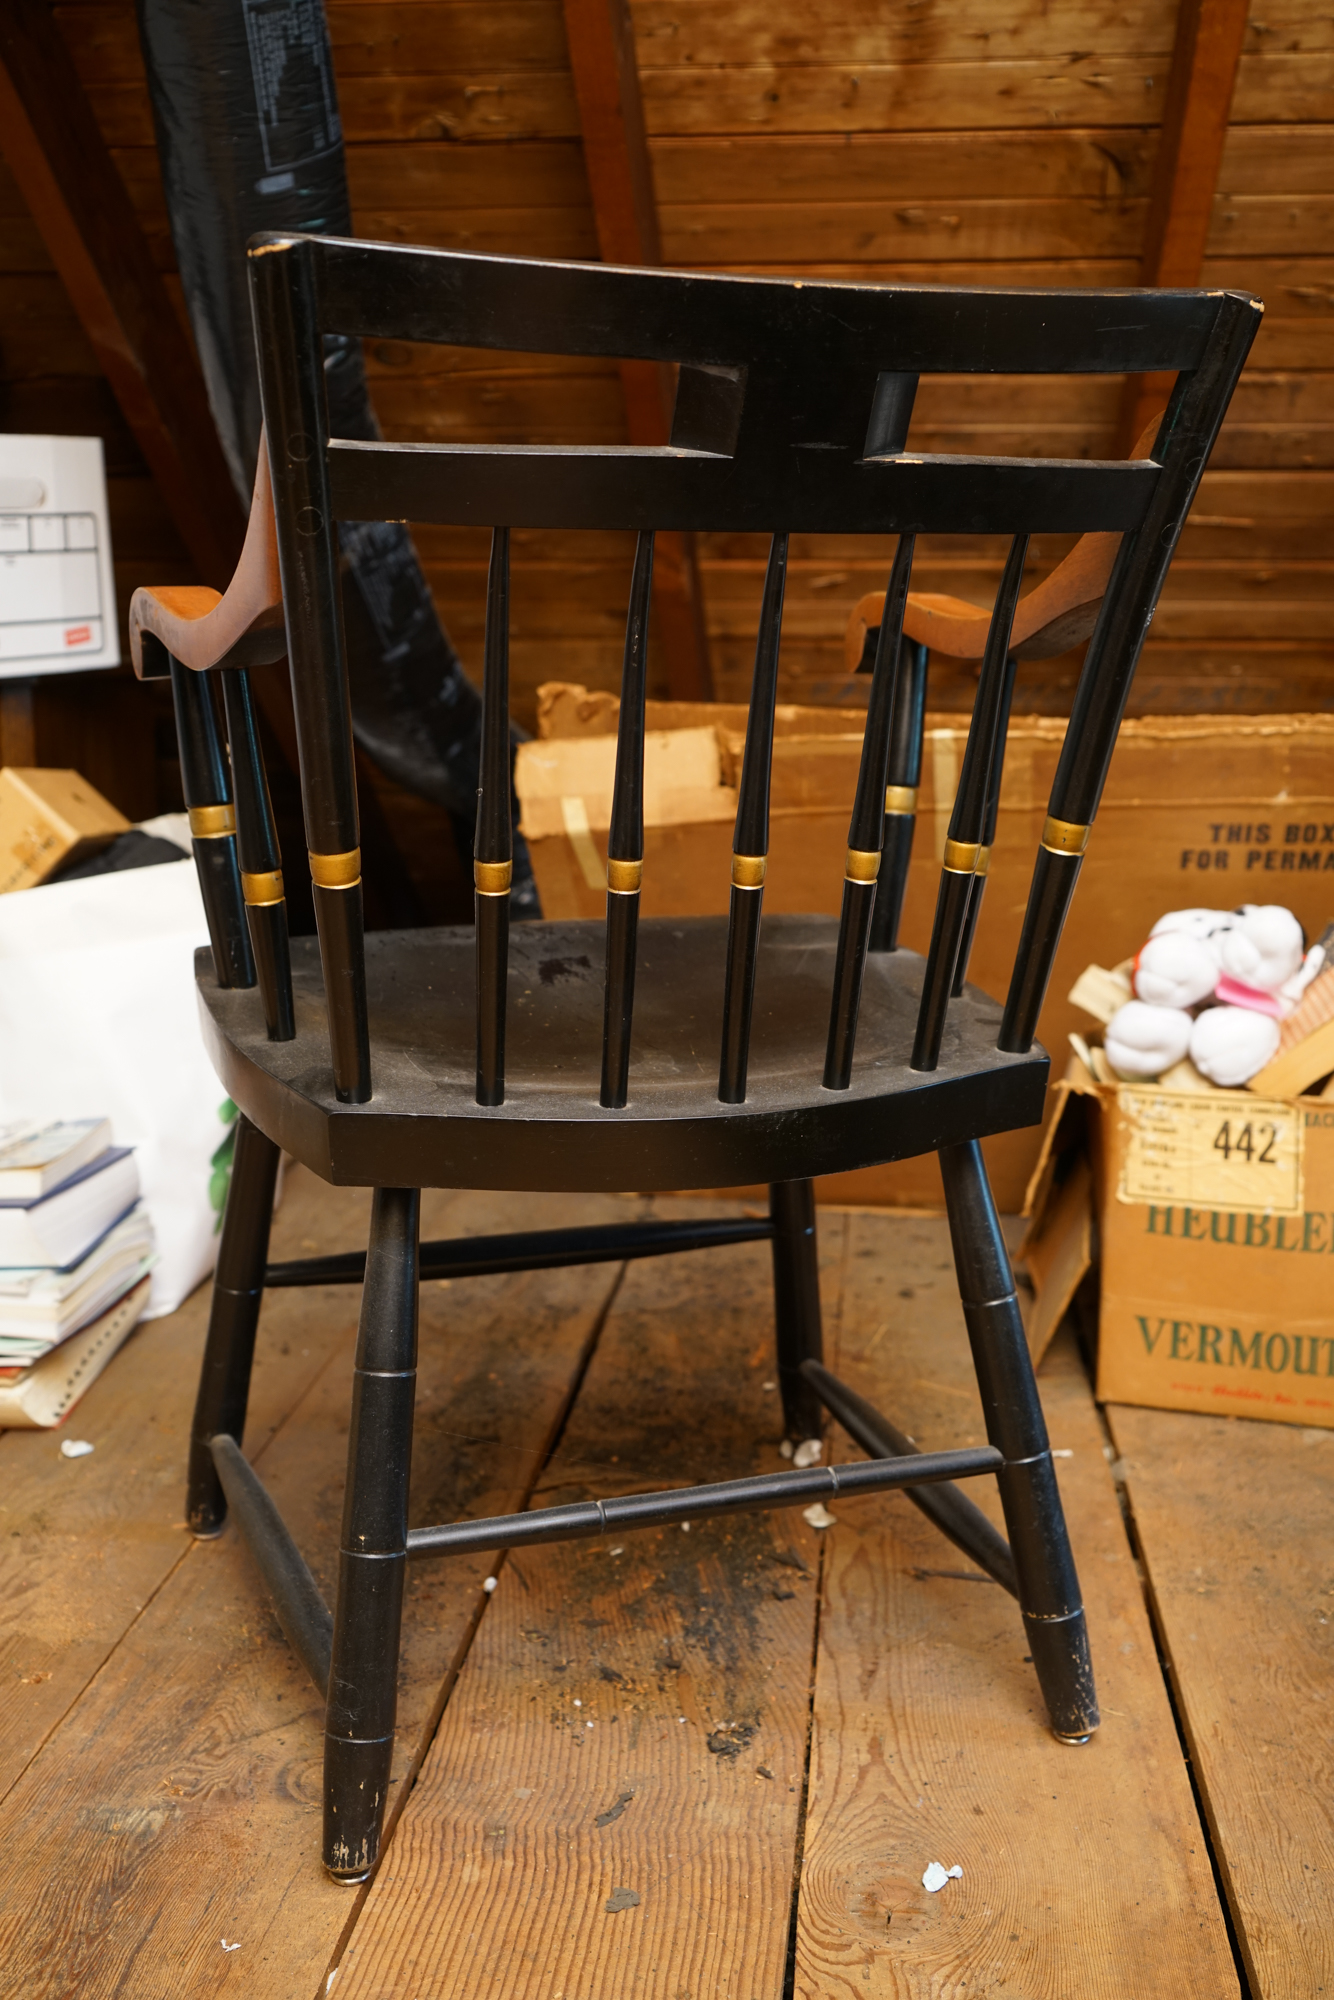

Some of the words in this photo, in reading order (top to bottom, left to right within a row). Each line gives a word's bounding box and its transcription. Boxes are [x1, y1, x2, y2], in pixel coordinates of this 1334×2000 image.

[1210, 823, 1271, 844] THIS
[1284, 823, 1334, 844] BOX
[1179, 849, 1229, 871] FOR
[1213, 1120, 1277, 1164] 442
